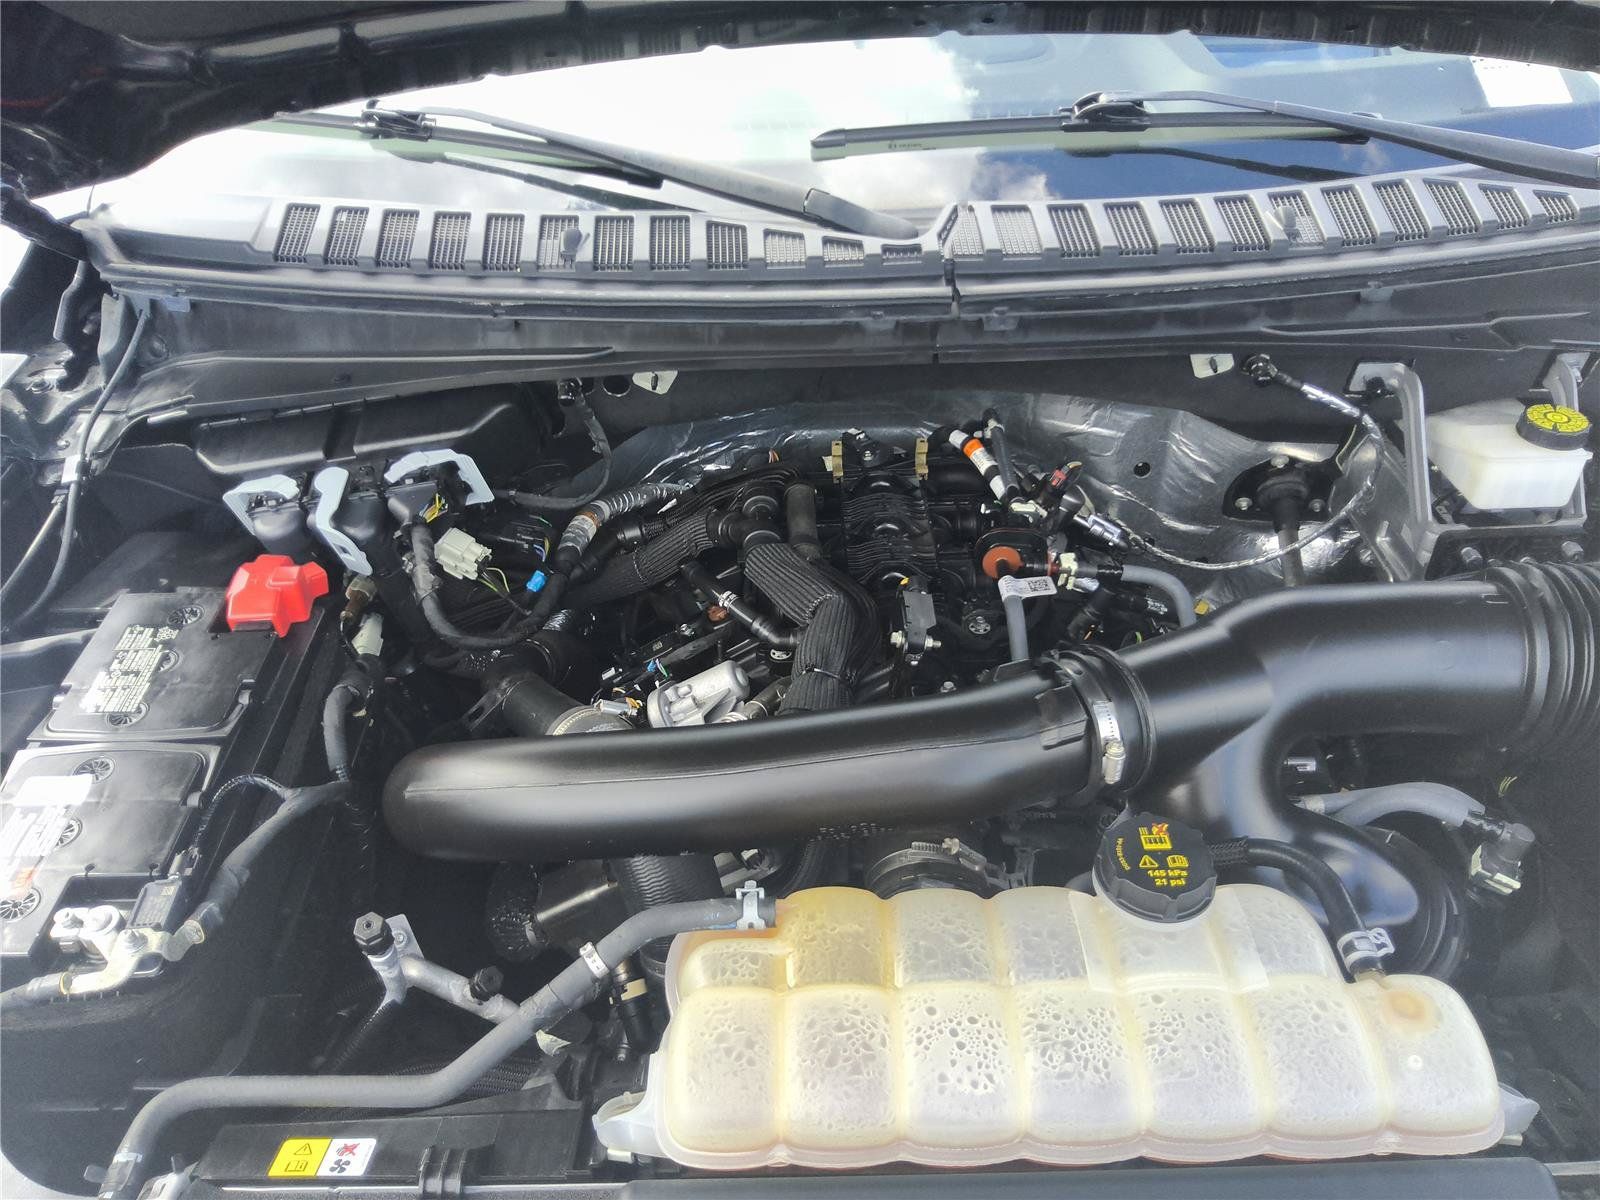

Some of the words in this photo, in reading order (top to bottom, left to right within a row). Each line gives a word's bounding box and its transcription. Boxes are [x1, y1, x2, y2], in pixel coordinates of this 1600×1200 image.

[1147, 869, 1166, 877] 145
[1168, 869, 1189, 877] kPa
[1154, 878, 1168, 886] 21
[1170, 877, 1186, 887] psi
